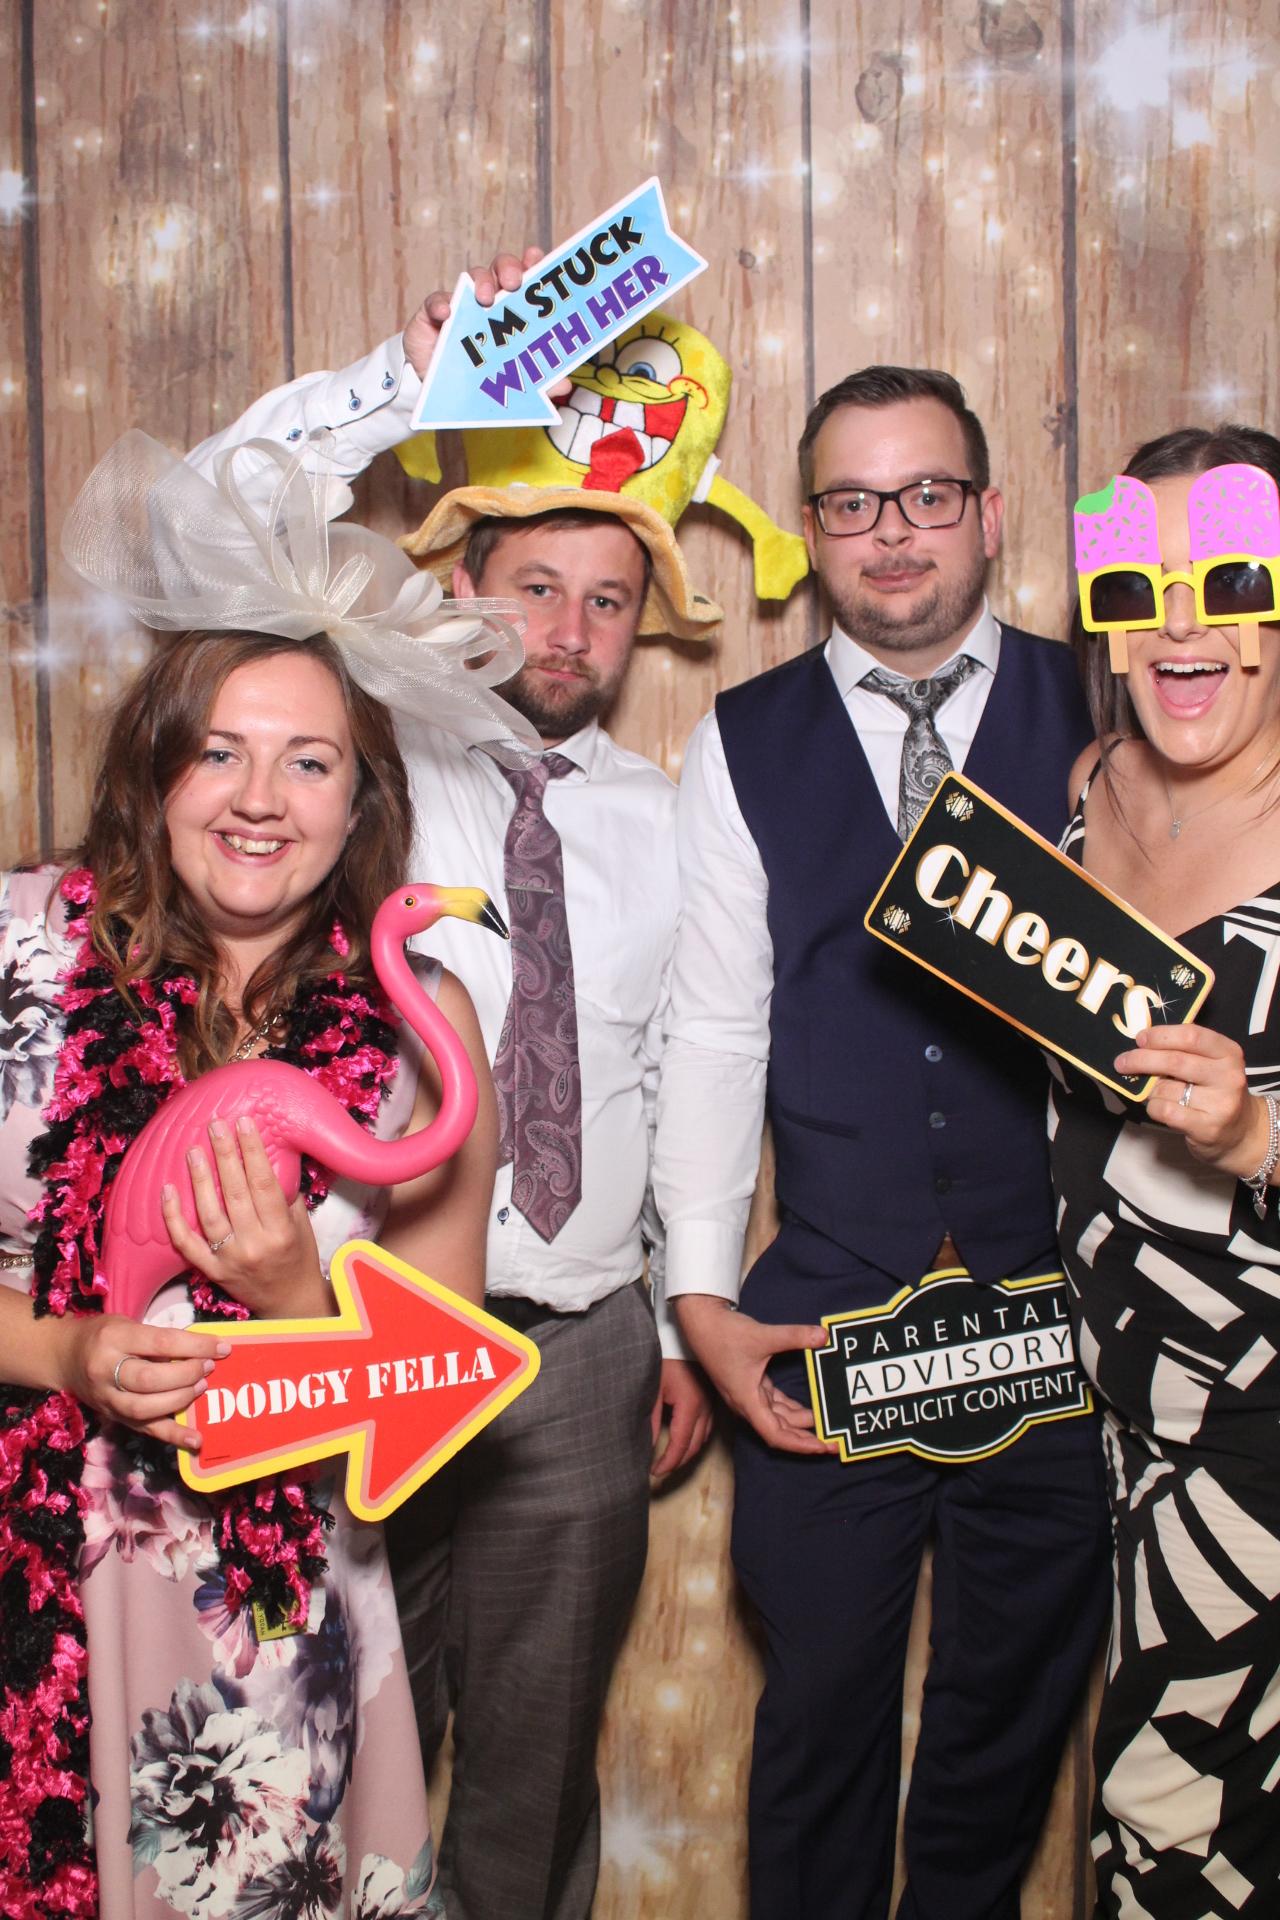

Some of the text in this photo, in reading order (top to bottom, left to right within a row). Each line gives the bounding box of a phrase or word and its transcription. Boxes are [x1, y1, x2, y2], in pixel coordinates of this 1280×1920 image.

[460, 216, 643, 368] I'M STUCK
[479, 255, 671, 408] WITH HER
[915, 844, 1164, 1040] Cheers
[844, 1298, 1067, 1359] PARENTAL
[851, 1329, 1069, 1399] ADVISORY
[204, 1347, 497, 1425] DODGY FELLA
[854, 1371, 1076, 1435] EXPLICIT CONTENT
